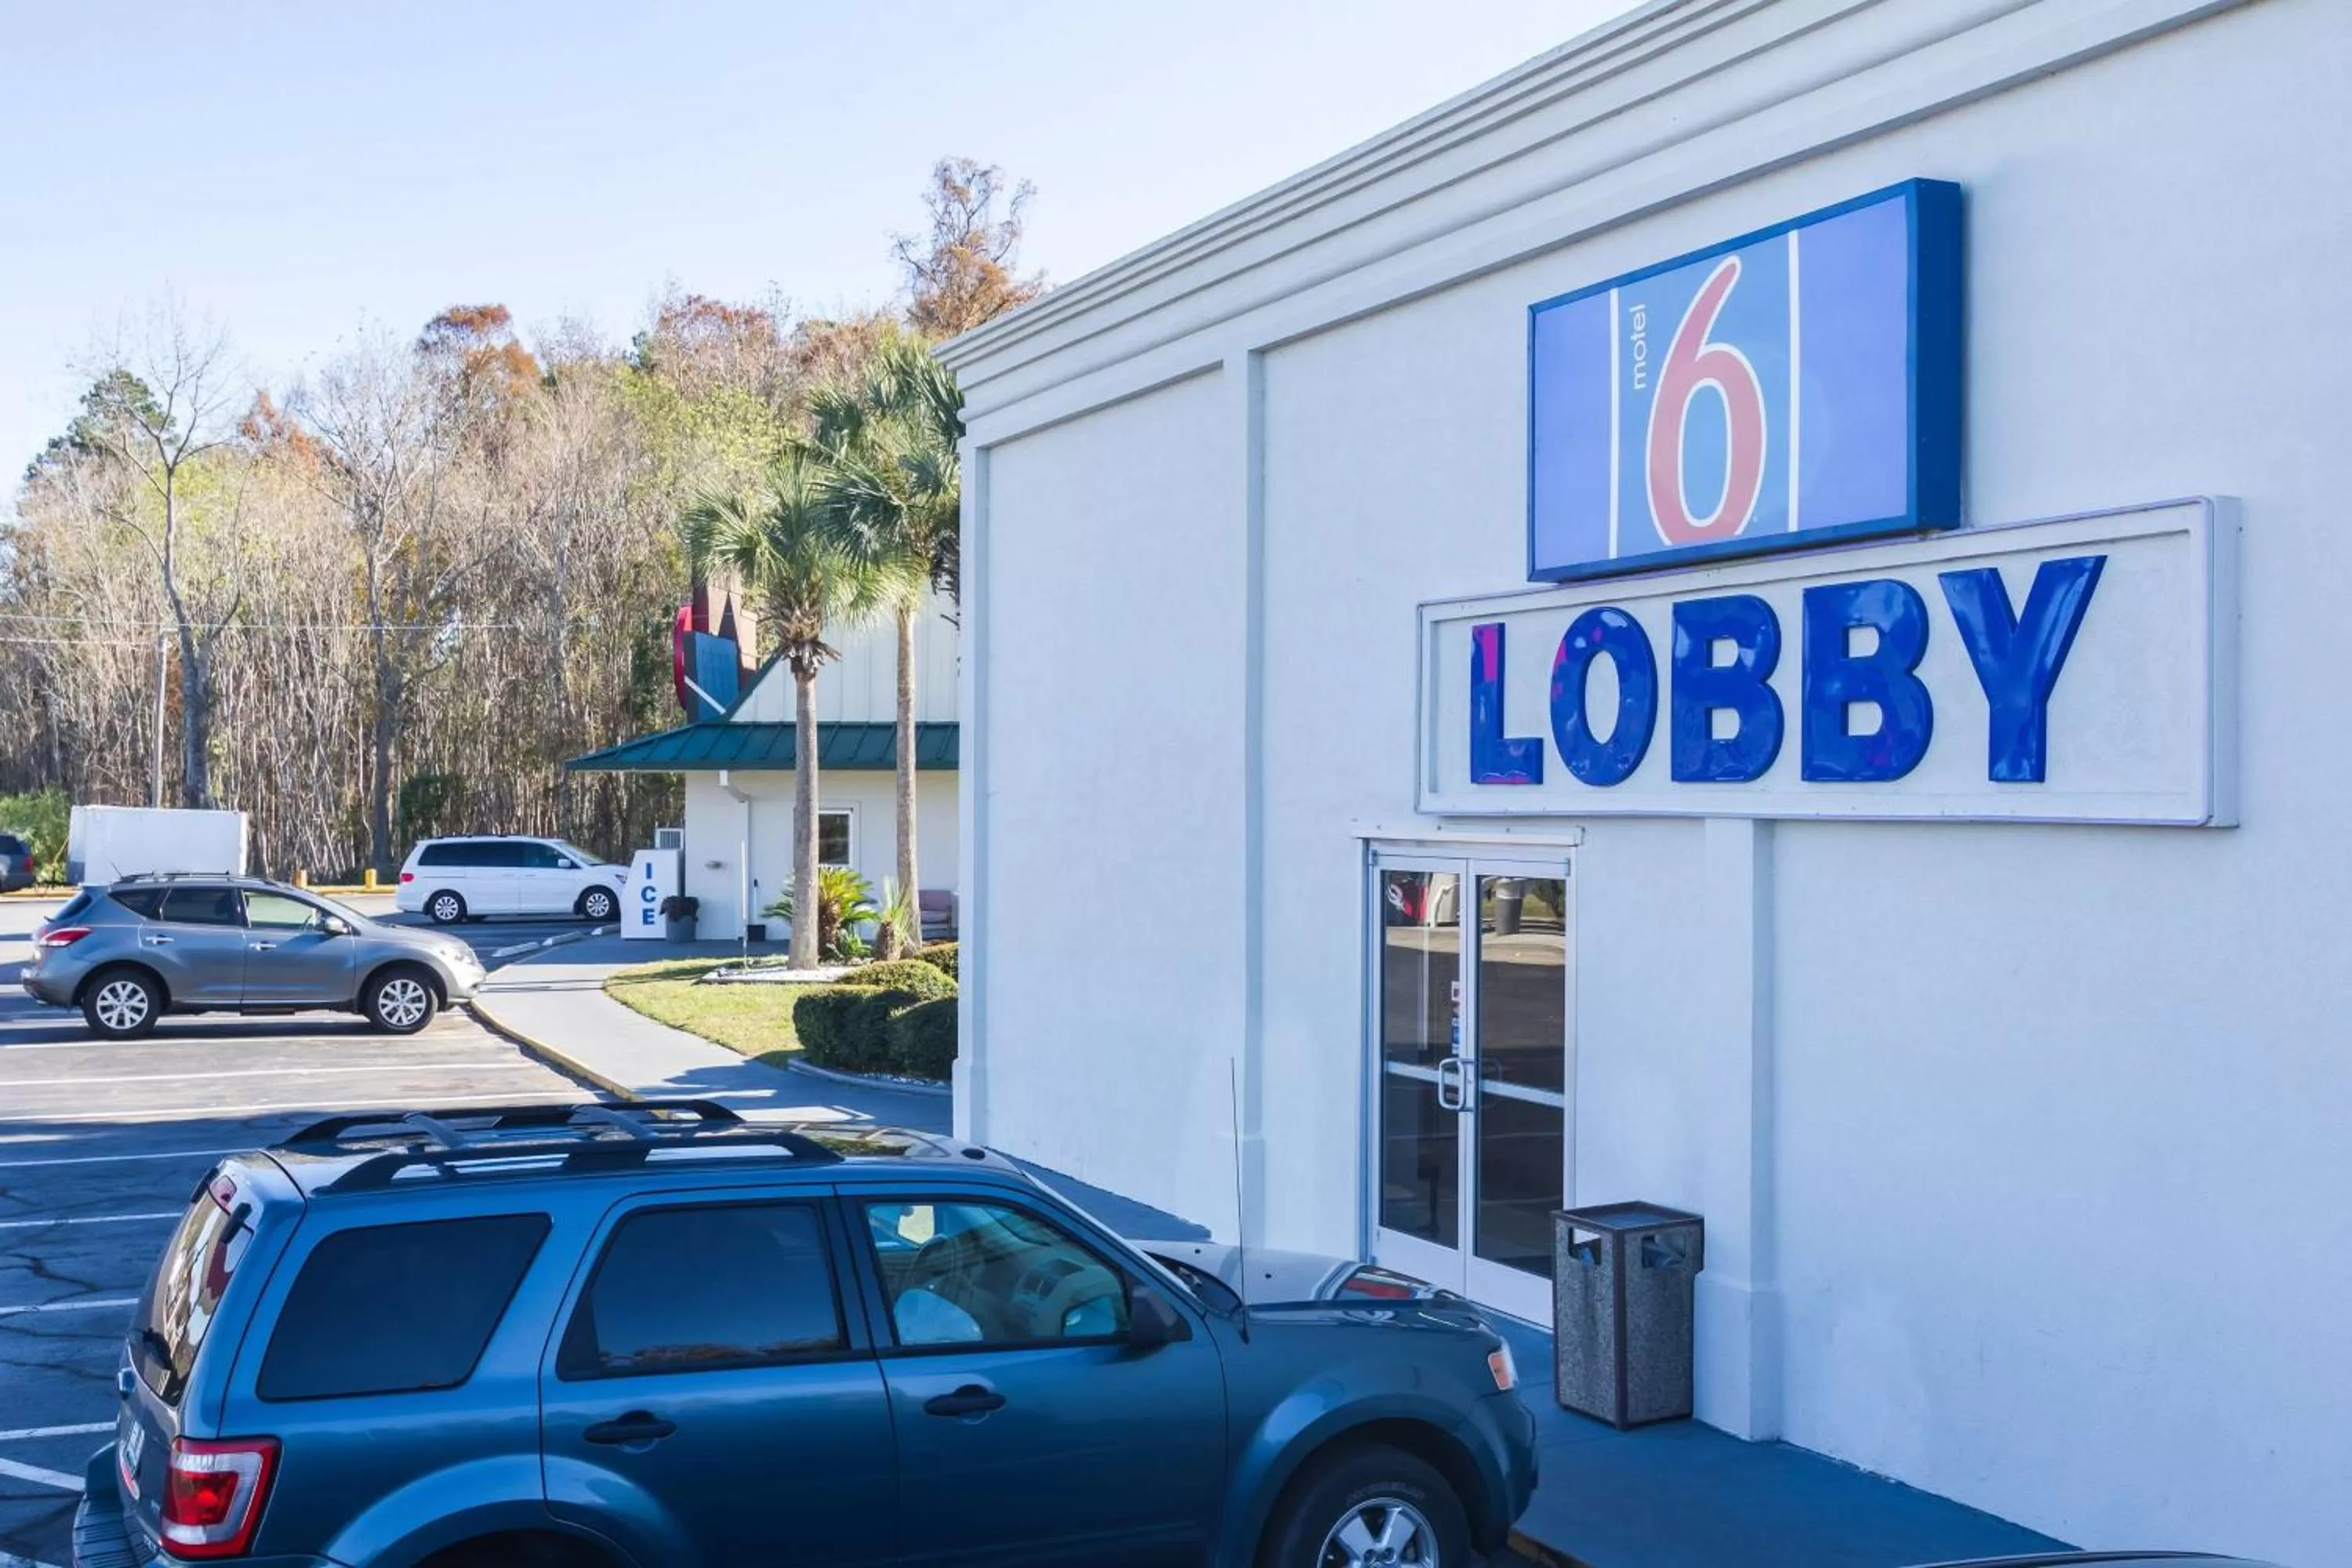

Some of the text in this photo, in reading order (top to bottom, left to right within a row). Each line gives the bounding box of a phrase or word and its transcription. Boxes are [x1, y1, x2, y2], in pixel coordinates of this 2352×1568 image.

[1629, 255, 1766, 546] motel 6
[1470, 554, 2107, 787] LOBBY
[641, 862, 657, 926] ICE
